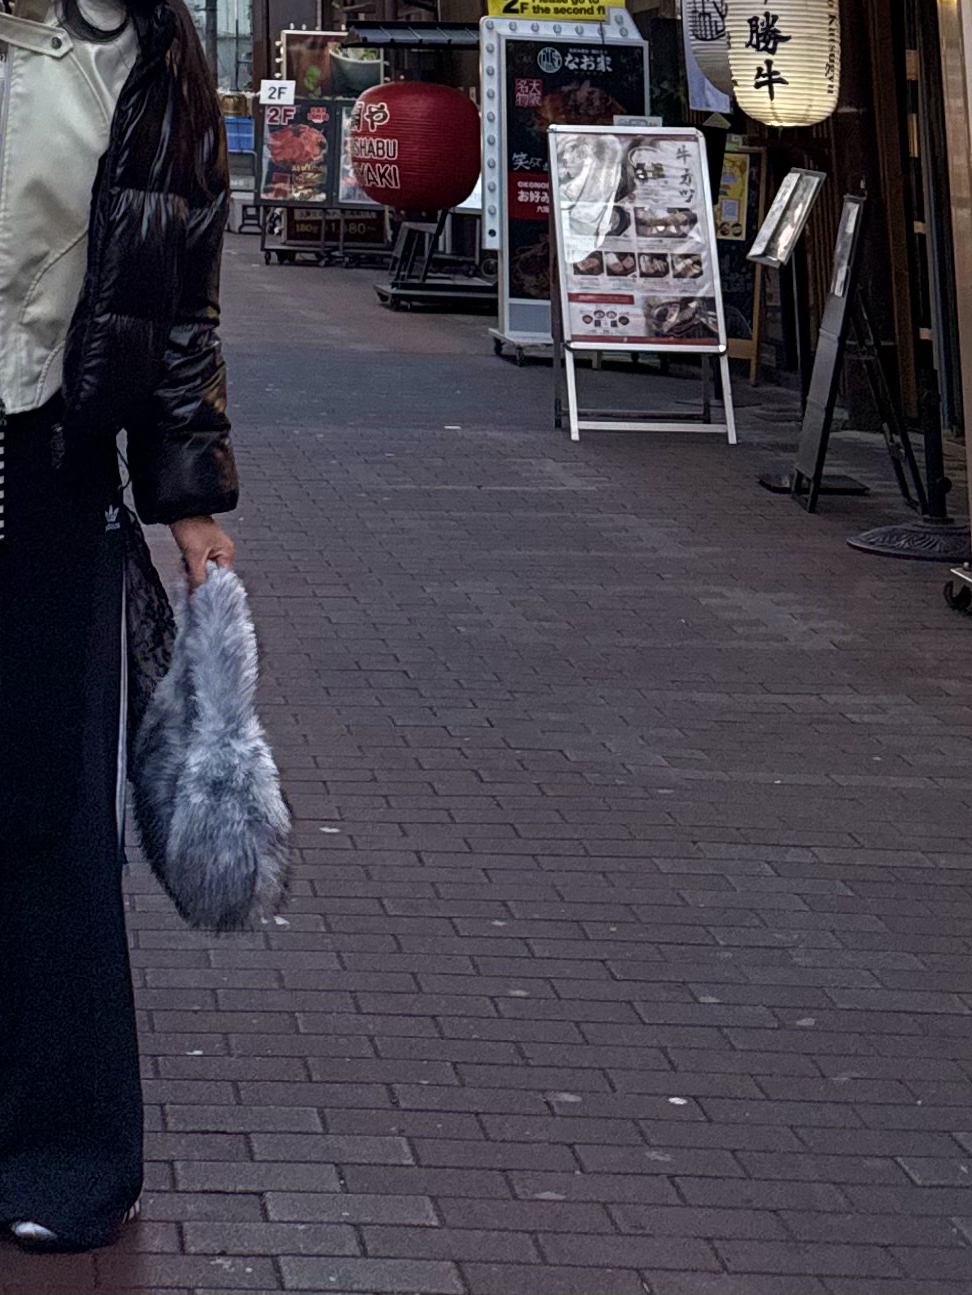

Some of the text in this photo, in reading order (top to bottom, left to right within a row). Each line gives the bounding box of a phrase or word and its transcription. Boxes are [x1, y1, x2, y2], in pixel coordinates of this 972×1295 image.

[532, 5, 551, 14] the
[553, 6, 594, 15] second
[564, 53, 613, 73] なお家
[268, 87, 287, 100] 2F
[266, 106, 296, 125] 2F
